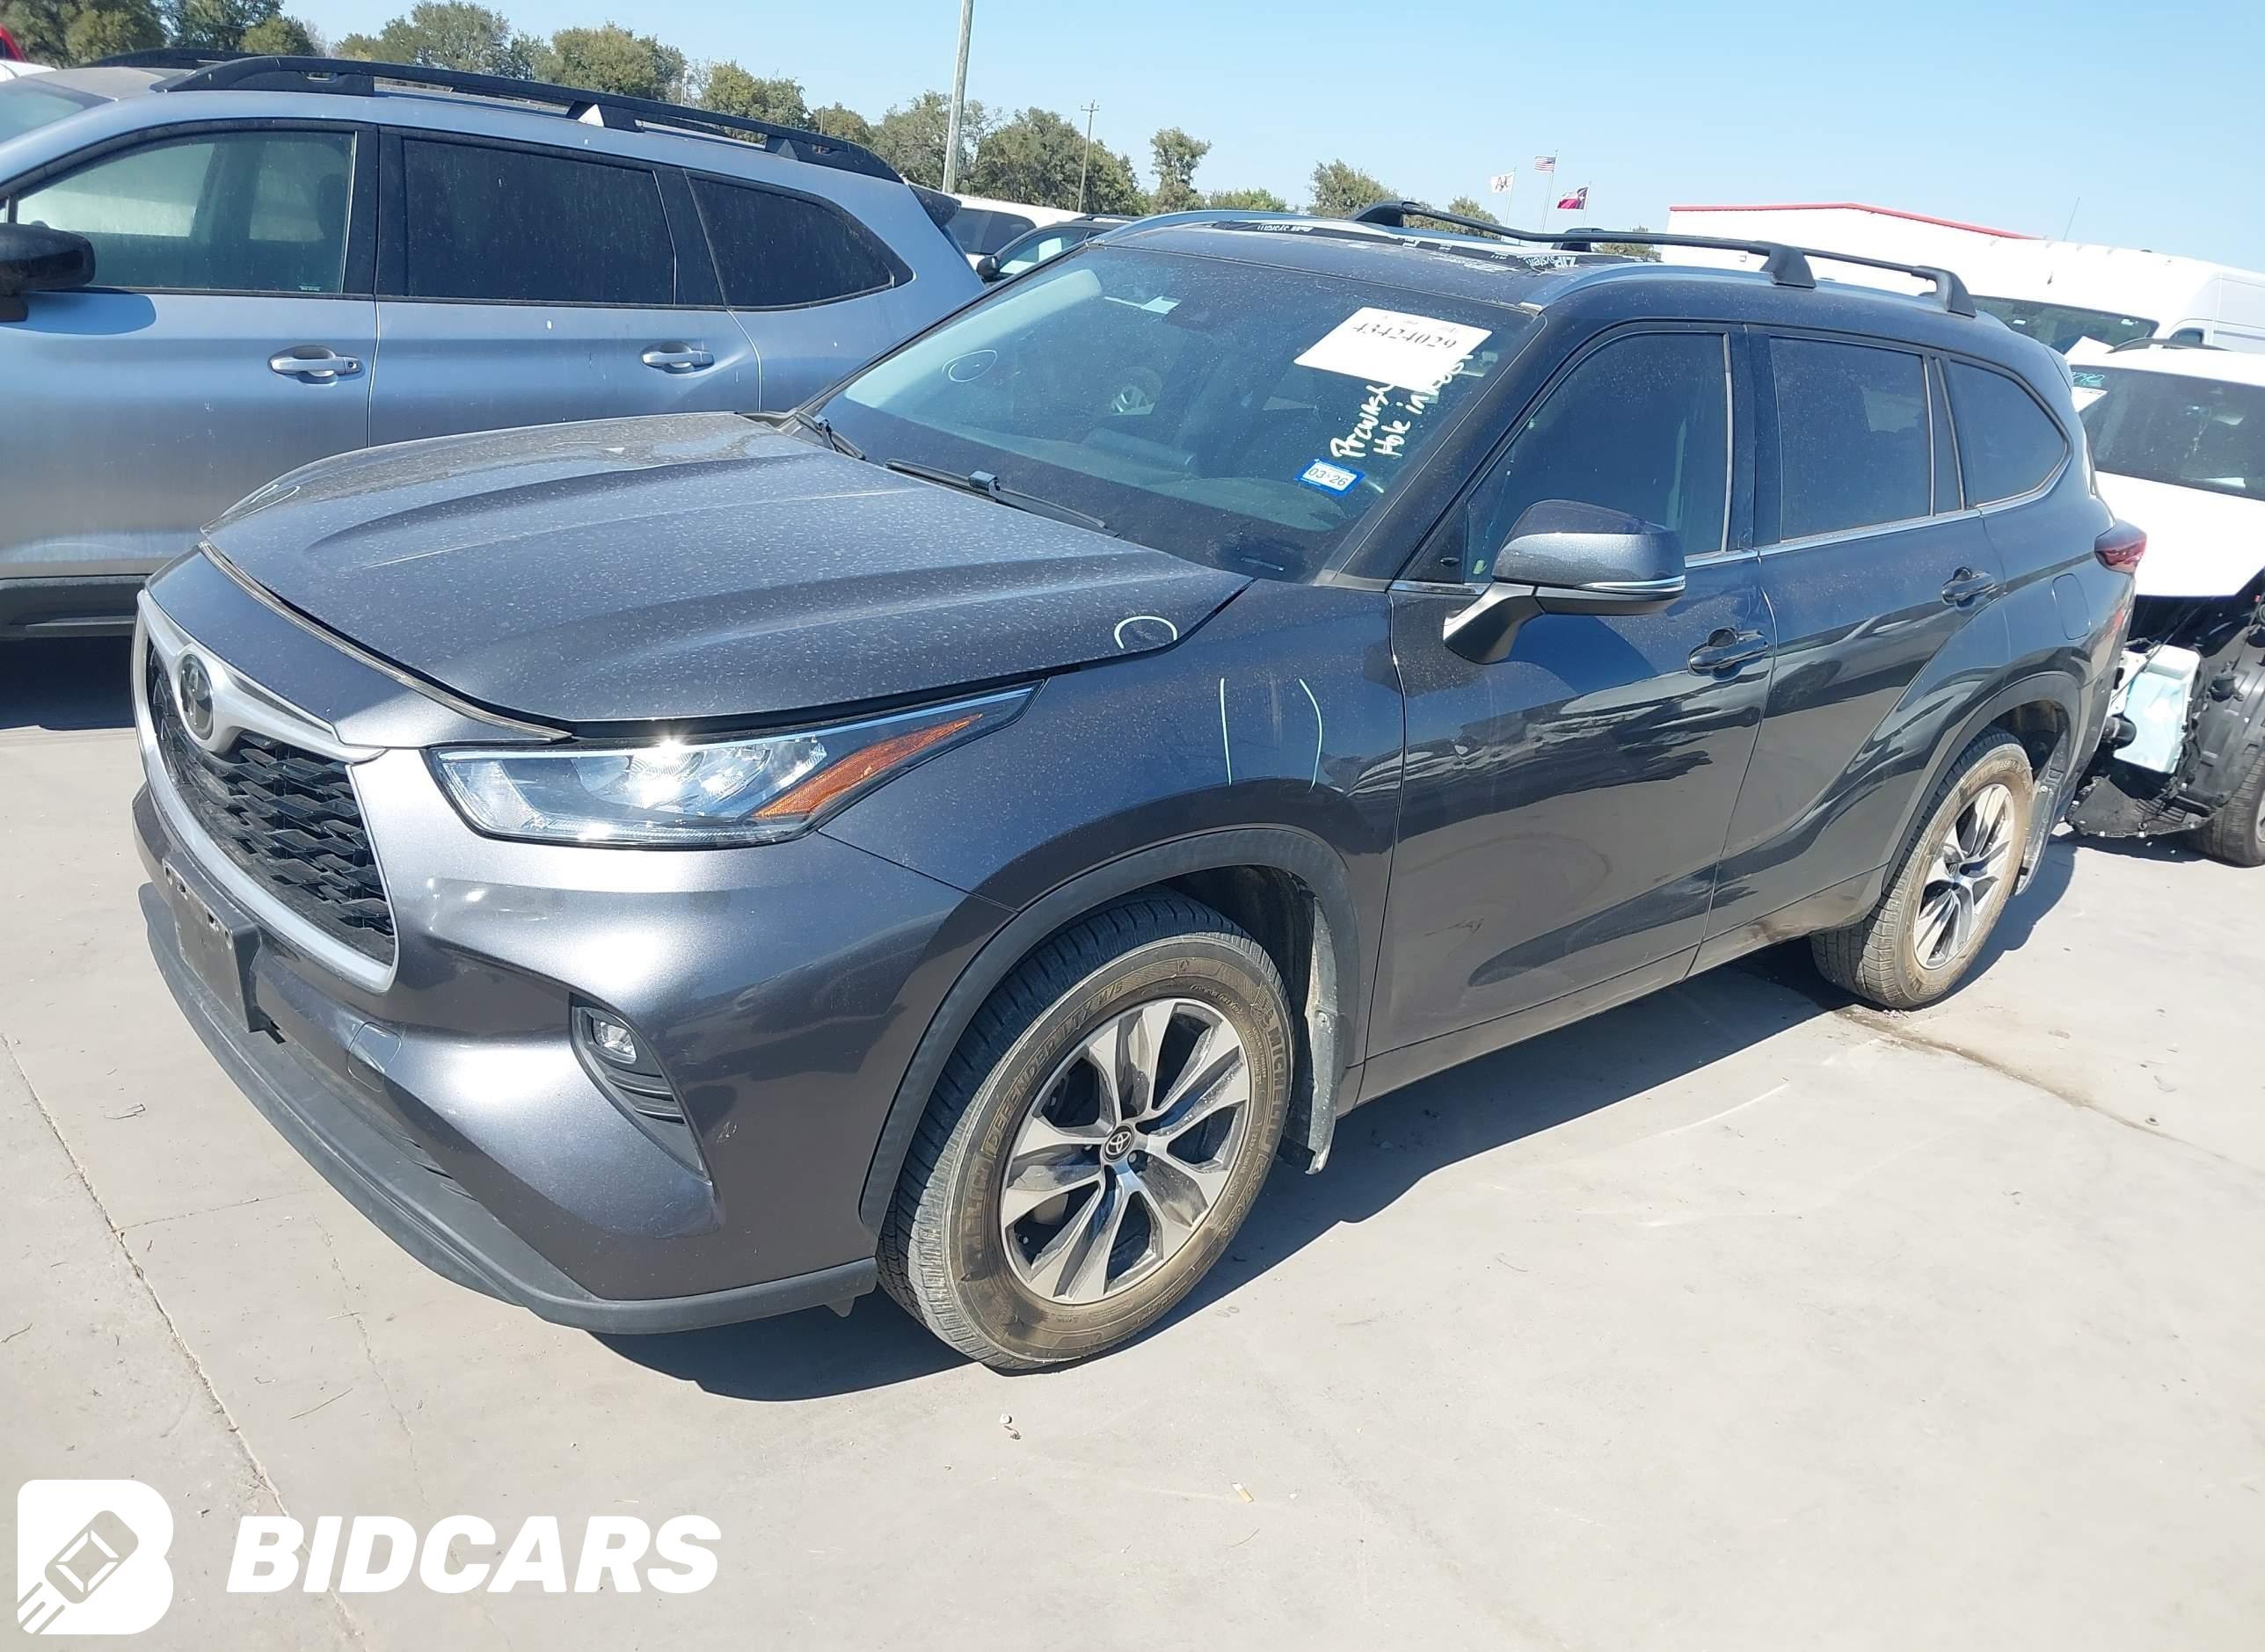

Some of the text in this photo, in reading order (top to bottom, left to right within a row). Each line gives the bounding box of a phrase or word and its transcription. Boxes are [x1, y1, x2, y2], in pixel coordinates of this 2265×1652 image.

[1353, 323, 1457, 348] 43424029
[1395, 394, 1430, 415] in
[986, 1037, 1057, 1147] DEFENDER
[1264, 1026, 1286, 1149] MICHELIN
